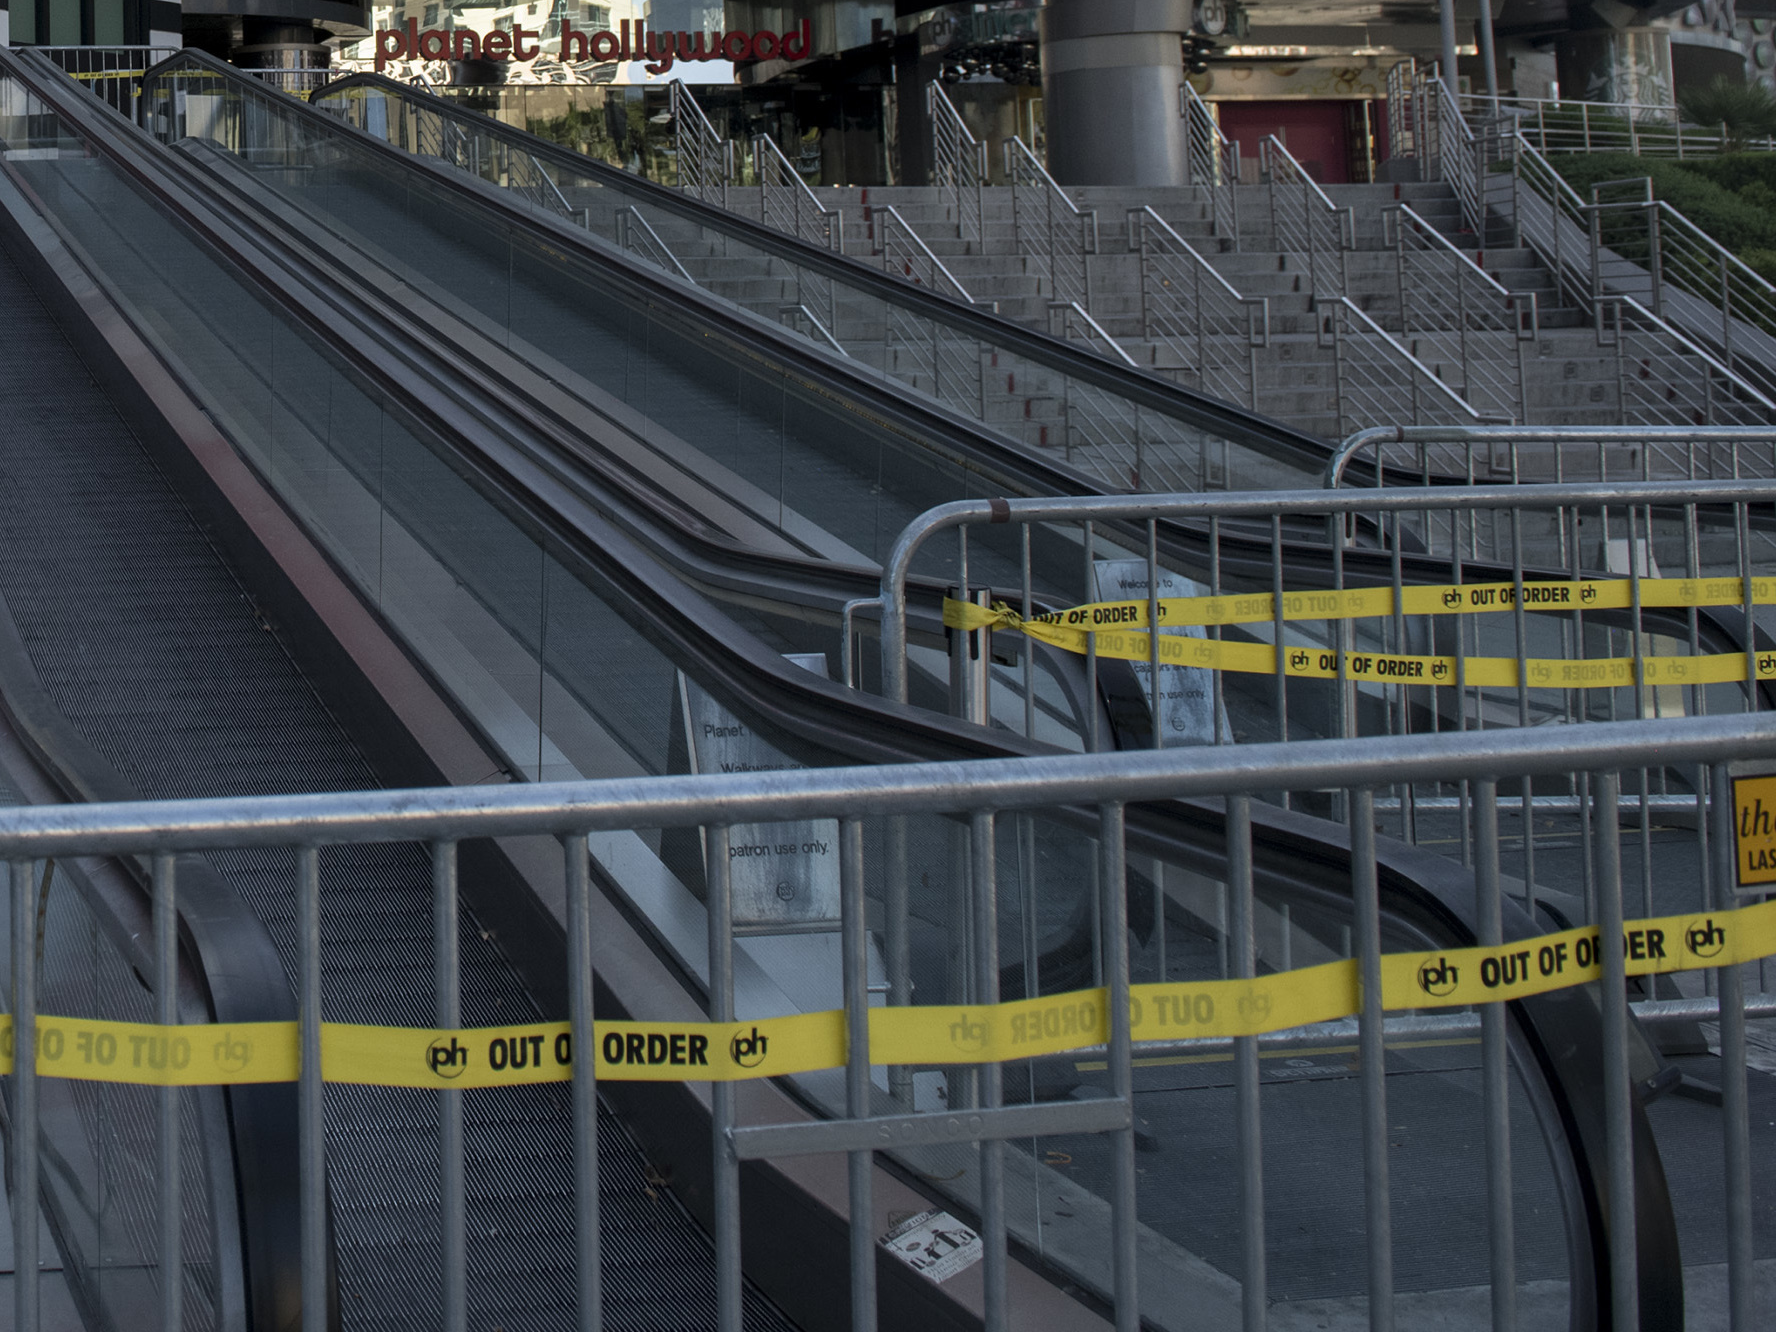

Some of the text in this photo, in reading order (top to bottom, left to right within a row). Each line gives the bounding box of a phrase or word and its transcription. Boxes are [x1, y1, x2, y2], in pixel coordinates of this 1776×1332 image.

[375, 18, 540, 72] planet
[560, 18, 812, 75] hollywood
[1117, 578, 1173, 590] Welco to
[1441, 588, 1463, 608] ph
[1471, 589, 1496, 605] OUT
[1522, 587, 1570, 603] ORDER
[1579, 584, 1596, 603] ph
[1068, 609, 1088, 624] OF
[1093, 606, 1138, 624] ORDER
[1290, 651, 1448, 680] ph OU OF ORDER ph
[704, 724, 744, 739] Planet
[1740, 798, 1776, 838] th
[730, 840, 829, 860] patron use only.
[1418, 958, 1459, 996] ph
[1480, 951, 1531, 988] OUT
[1539, 942, 1568, 976] OF
[1685, 919, 1726, 957] ph
[426, 1027, 769, 1079] ph OUT O ORDER ph
